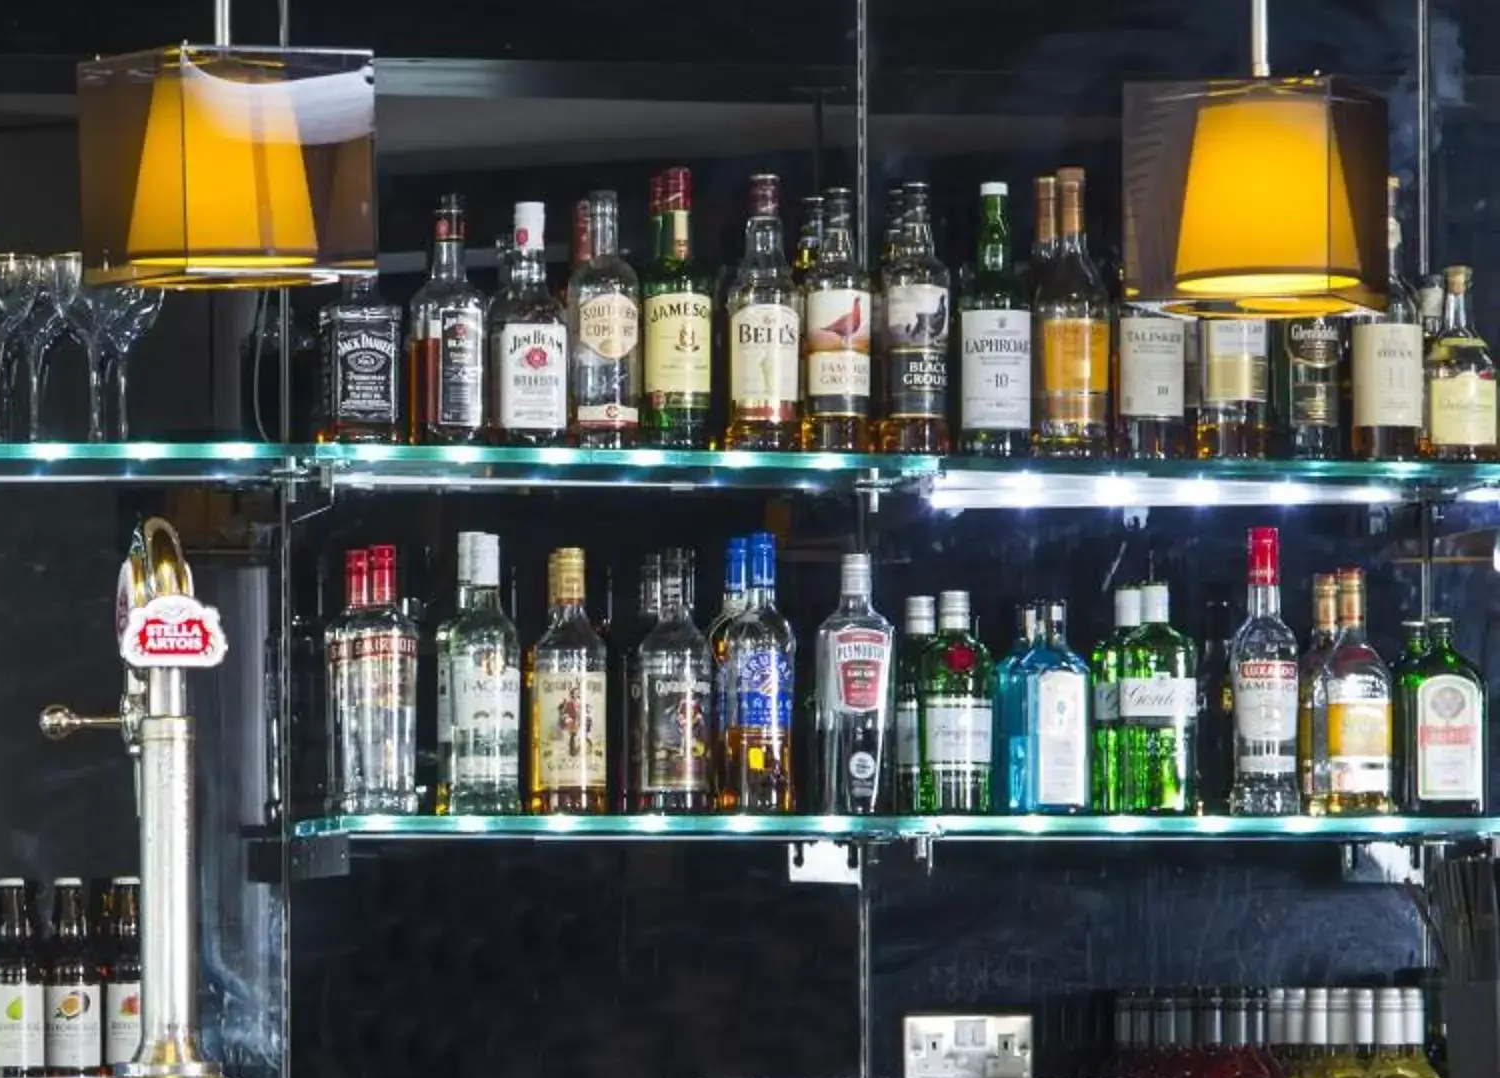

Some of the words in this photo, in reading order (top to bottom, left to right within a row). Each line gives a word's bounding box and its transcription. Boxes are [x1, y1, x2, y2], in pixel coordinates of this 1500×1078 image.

[582, 304, 637, 322] SOUTERN
[650, 302, 709, 323] JAMESO
[819, 363, 869, 373] FAMUS
[145, 623, 202, 637] STELLA
[145, 637, 202, 651] ARTOIS
[353, 636, 417, 657] SMIROFF
[742, 653, 791, 681] BRUAL
